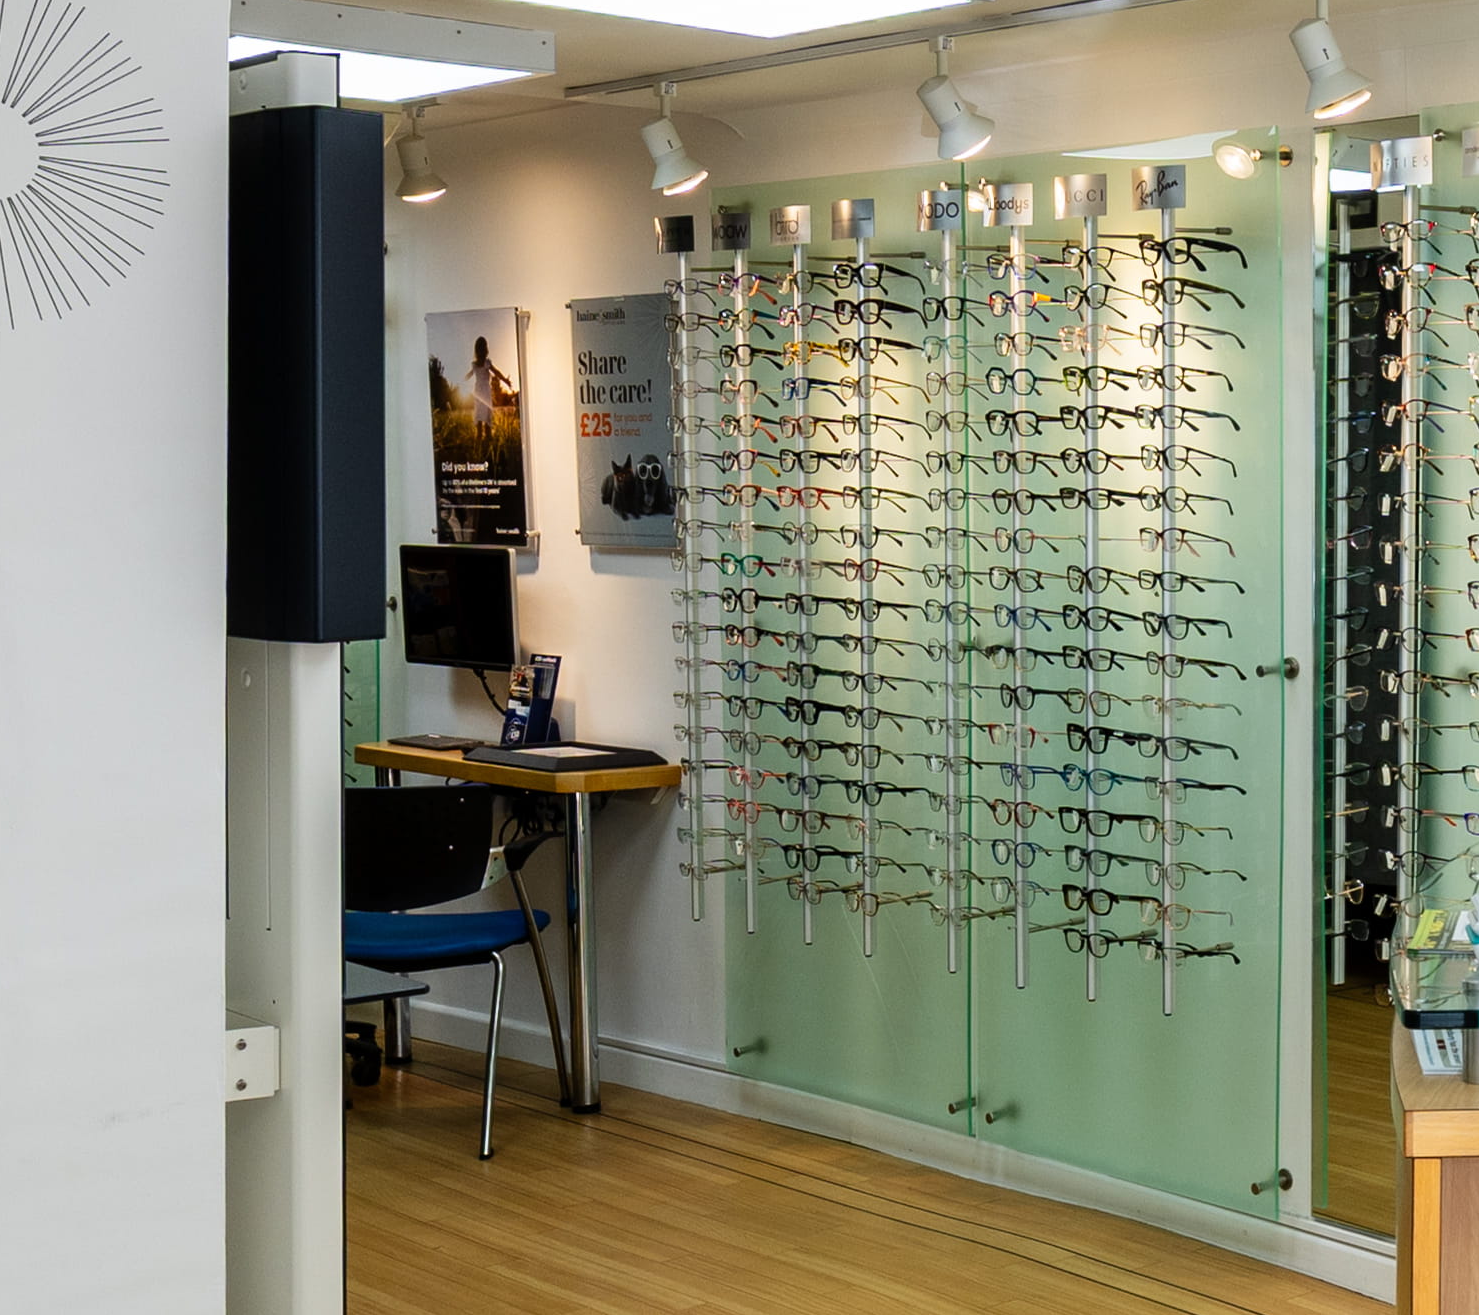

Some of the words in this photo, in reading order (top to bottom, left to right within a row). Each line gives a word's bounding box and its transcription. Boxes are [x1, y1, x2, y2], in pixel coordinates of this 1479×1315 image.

[1372, 154, 1429, 172] NFTIES
[1062, 189, 1104, 204] UCCI
[578, 350, 627, 376] Share
[580, 379, 606, 404] the
[609, 379, 652, 404] care!
[580, 413, 613, 437] £25
